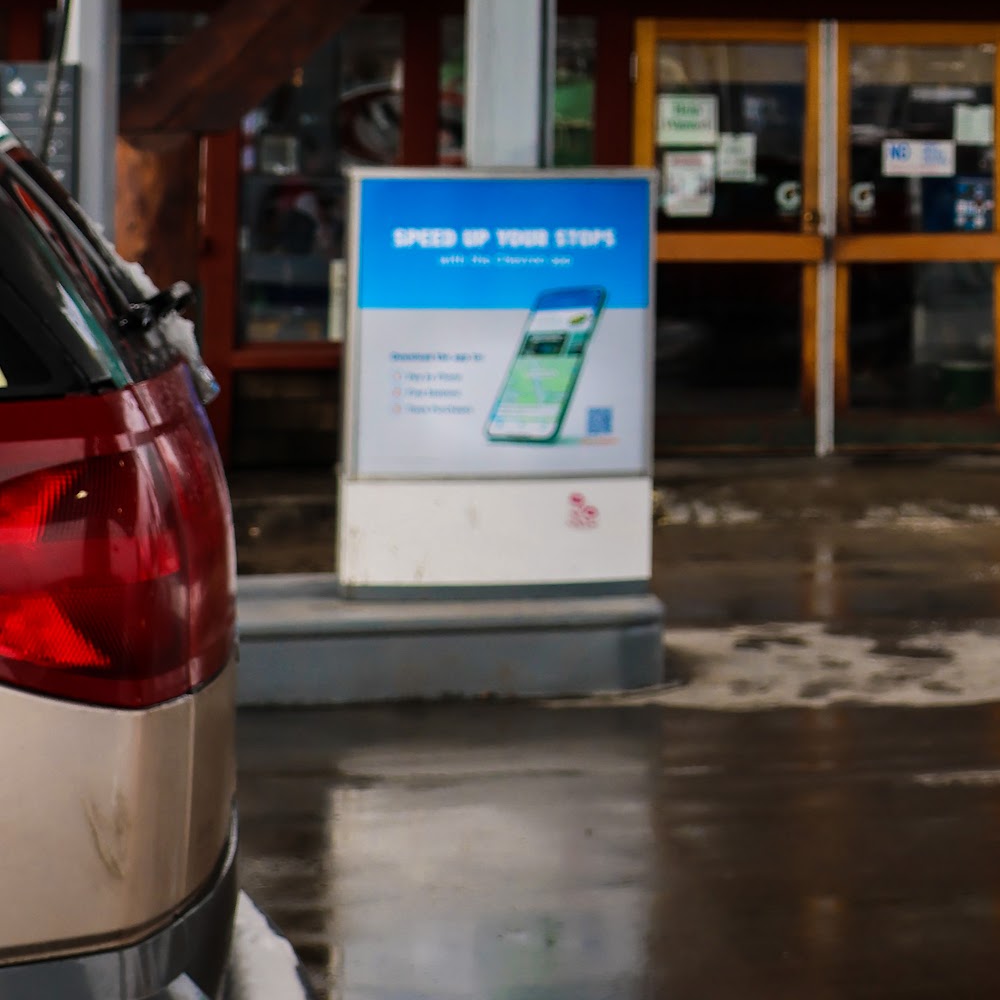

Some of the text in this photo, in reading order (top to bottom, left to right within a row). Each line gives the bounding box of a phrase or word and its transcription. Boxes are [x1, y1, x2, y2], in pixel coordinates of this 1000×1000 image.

[392, 227, 616, 248] SPEED UP YOUR STOPS
